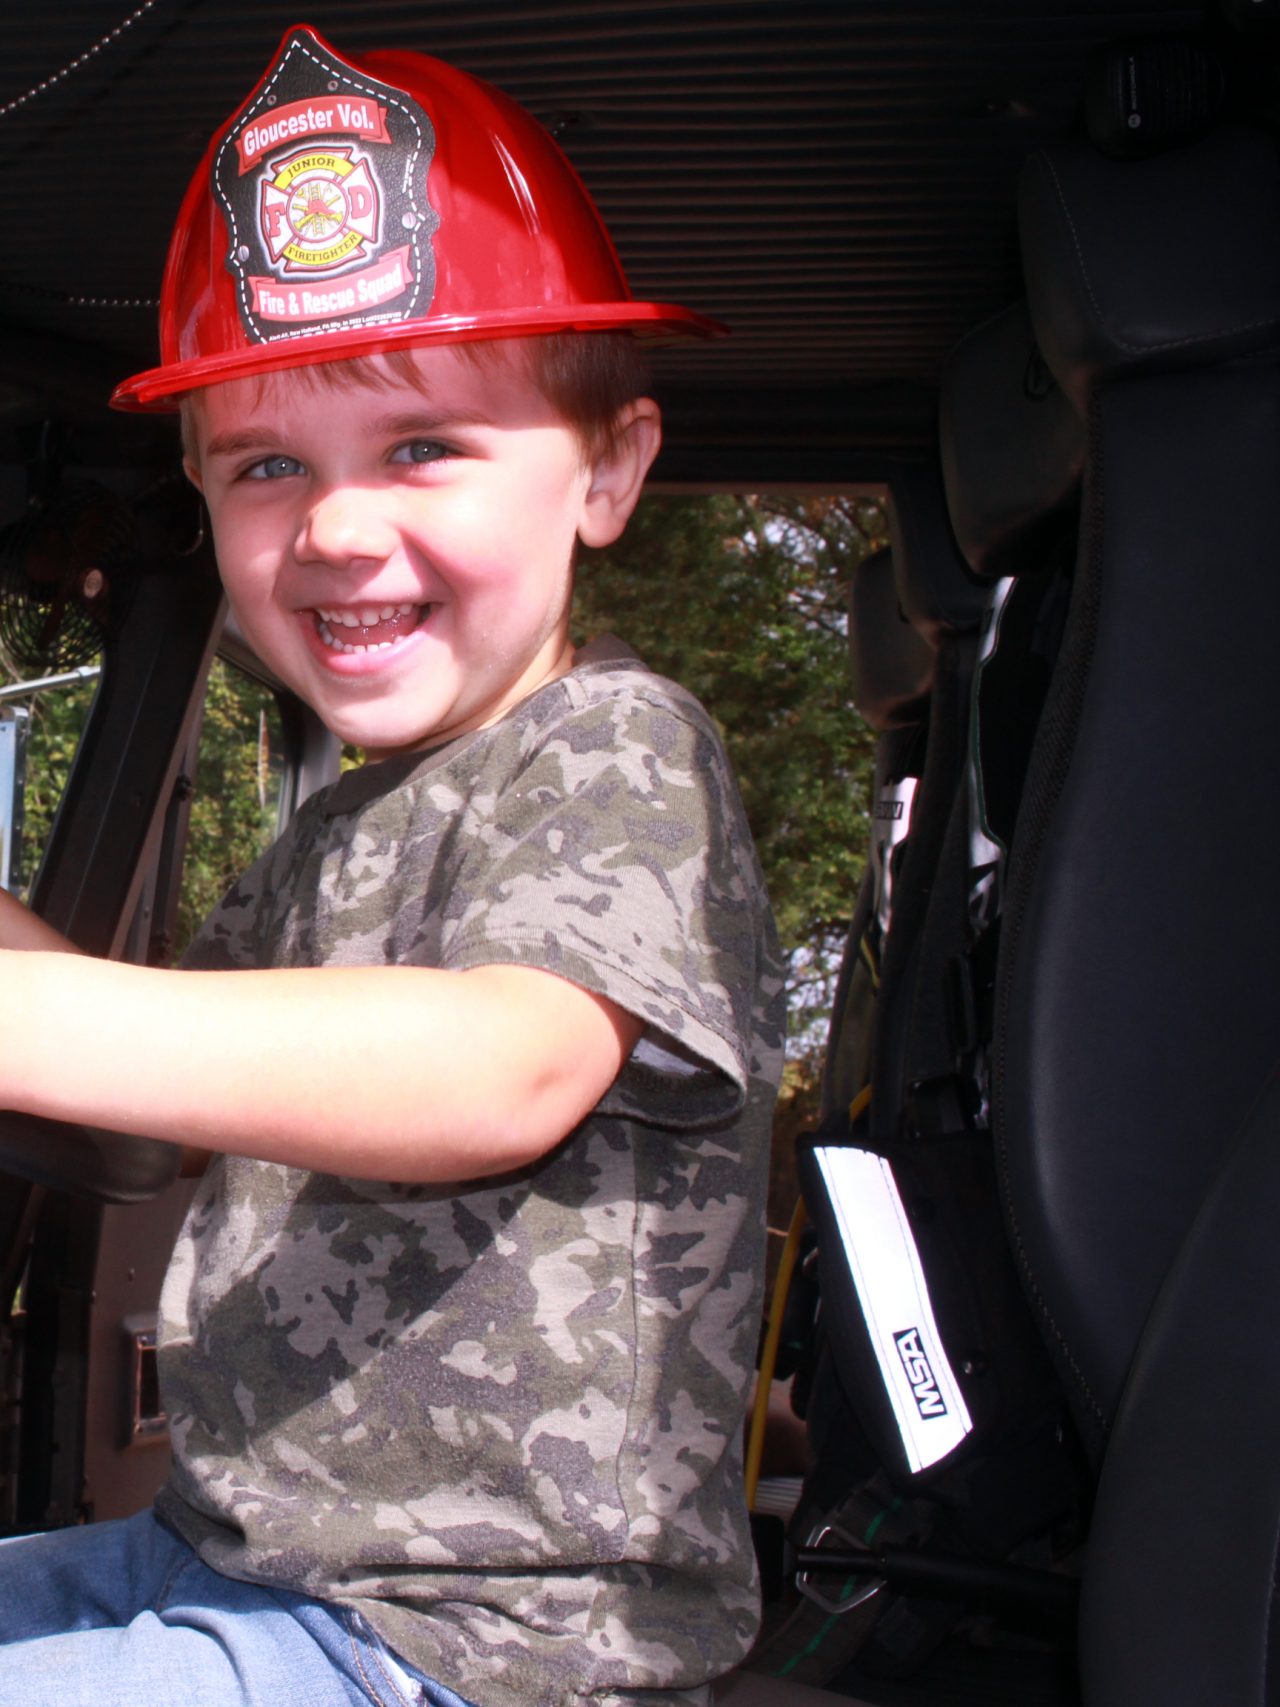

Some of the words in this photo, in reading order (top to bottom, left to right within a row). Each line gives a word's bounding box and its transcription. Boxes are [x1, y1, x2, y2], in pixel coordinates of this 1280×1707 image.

[243, 107, 334, 156] Gloucester
[337, 103, 375, 130] Vol.
[287, 157, 335, 177] JUNIOR
[266, 202, 286, 238] F
[348, 185, 372, 219] D
[288, 234, 358, 262] FIREFIGHTER
[259, 290, 285, 315] Fire
[288, 292, 299, 315] &
[302, 288, 355, 314] Rescue
[357, 263, 401, 303] Squad
[897, 1328, 945, 1415] MSA
